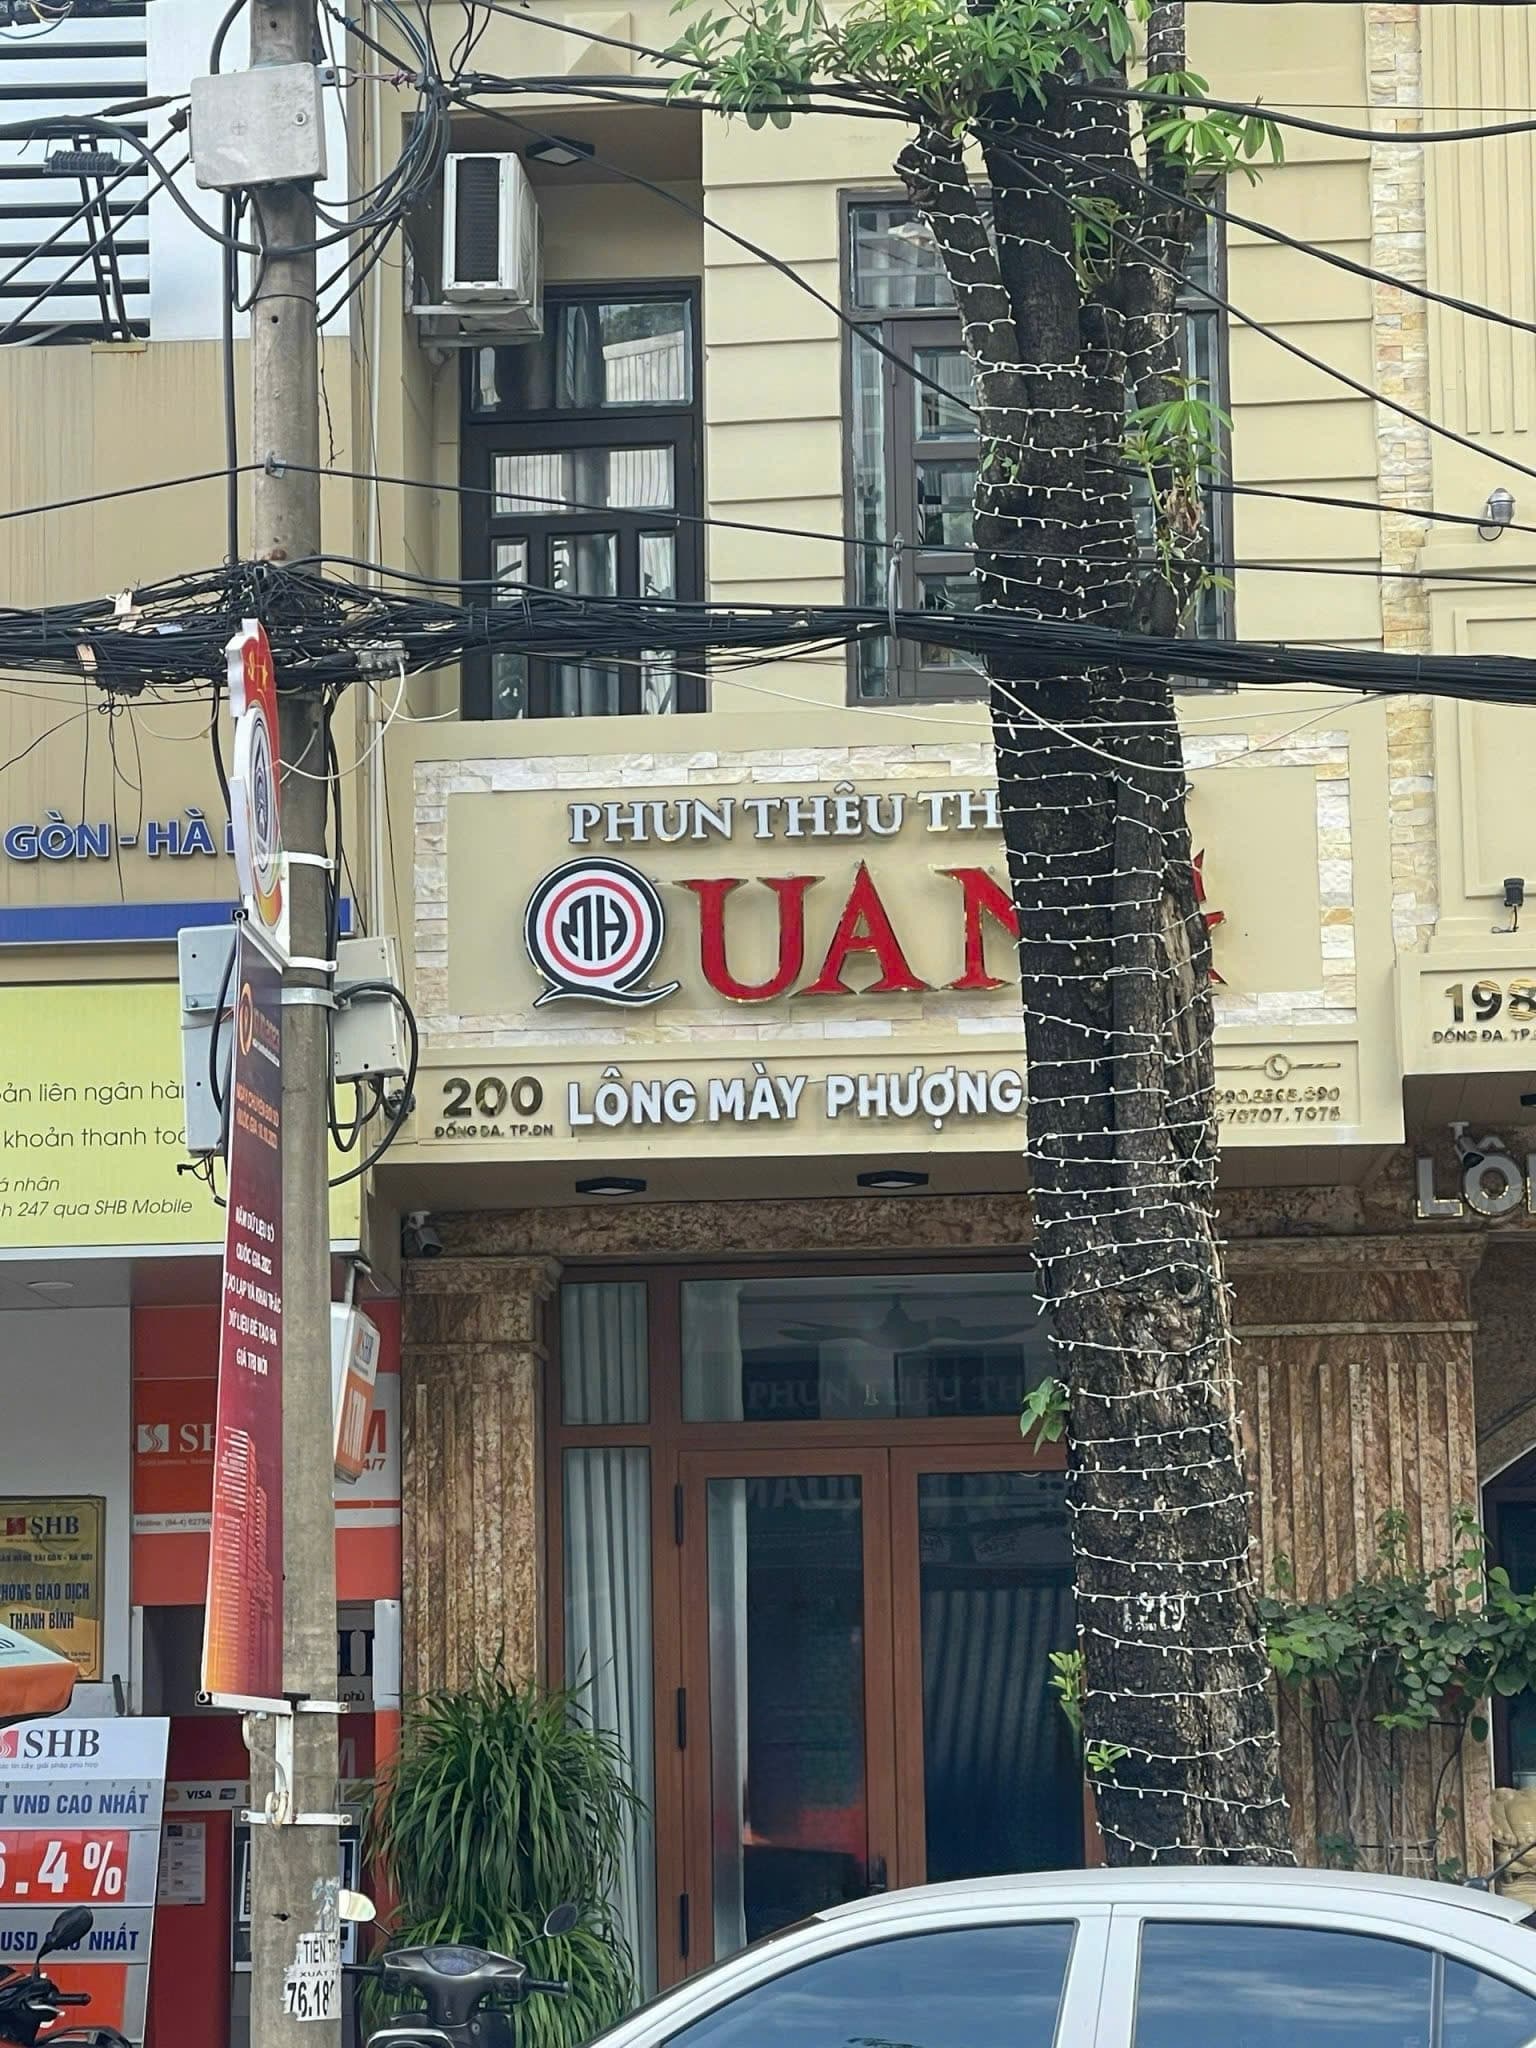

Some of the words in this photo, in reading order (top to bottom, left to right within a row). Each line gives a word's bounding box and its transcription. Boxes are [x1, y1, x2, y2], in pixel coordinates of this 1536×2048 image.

[568, 797, 737, 843] PHUN
[743, 780, 906, 840] THÊU
[4, 809, 110, 861] GÒN
[146, 808, 217, 857] HÀ
[1444, 979, 1536, 1022] 198
[39, 1083, 77, 1102] liên
[85, 1081, 143, 1105] ngân
[151, 1080, 184, 1100] hà
[443, 1076, 543, 1118] 200
[567, 1066, 697, 1127] LÔNG
[708, 1062, 808, 1122] MÀY
[826, 1066, 1024, 1130] PHƯỢNG
[4, 1126, 74, 1149] khoản
[81, 1126, 147, 1147] thanh
[434, 1120, 478, 1138] ĐỐNG
[14, 1176, 60, 1193] nhân
[1417, 1136, 1536, 1218] LÔ
[17, 1201, 49, 1218] 247
[53, 1202, 90, 1219] qua
[94, 1199, 128, 1216] SHB
[132, 1198, 193, 1215] Mobile
[31, 1515, 80, 1537] SHB
[36, 1582, 61, 1601] GIAO
[65, 1582, 89, 1605] DỊCH
[9, 1612, 45, 1630] THANH
[49, 1608, 74, 1630] BÌNH
[24, 1728, 100, 1759] SHB
[13, 1794, 50, 1815] VNĐ
[56, 1794, 93, 1815] CAO
[99, 1786, 149, 1814] NHẤT
[186, 1789, 212, 1800] VISA
[0, 1930, 38, 1951] USD
[89, 1922, 139, 1951] NHẤT
[287, 1979, 335, 2018] 76.18
